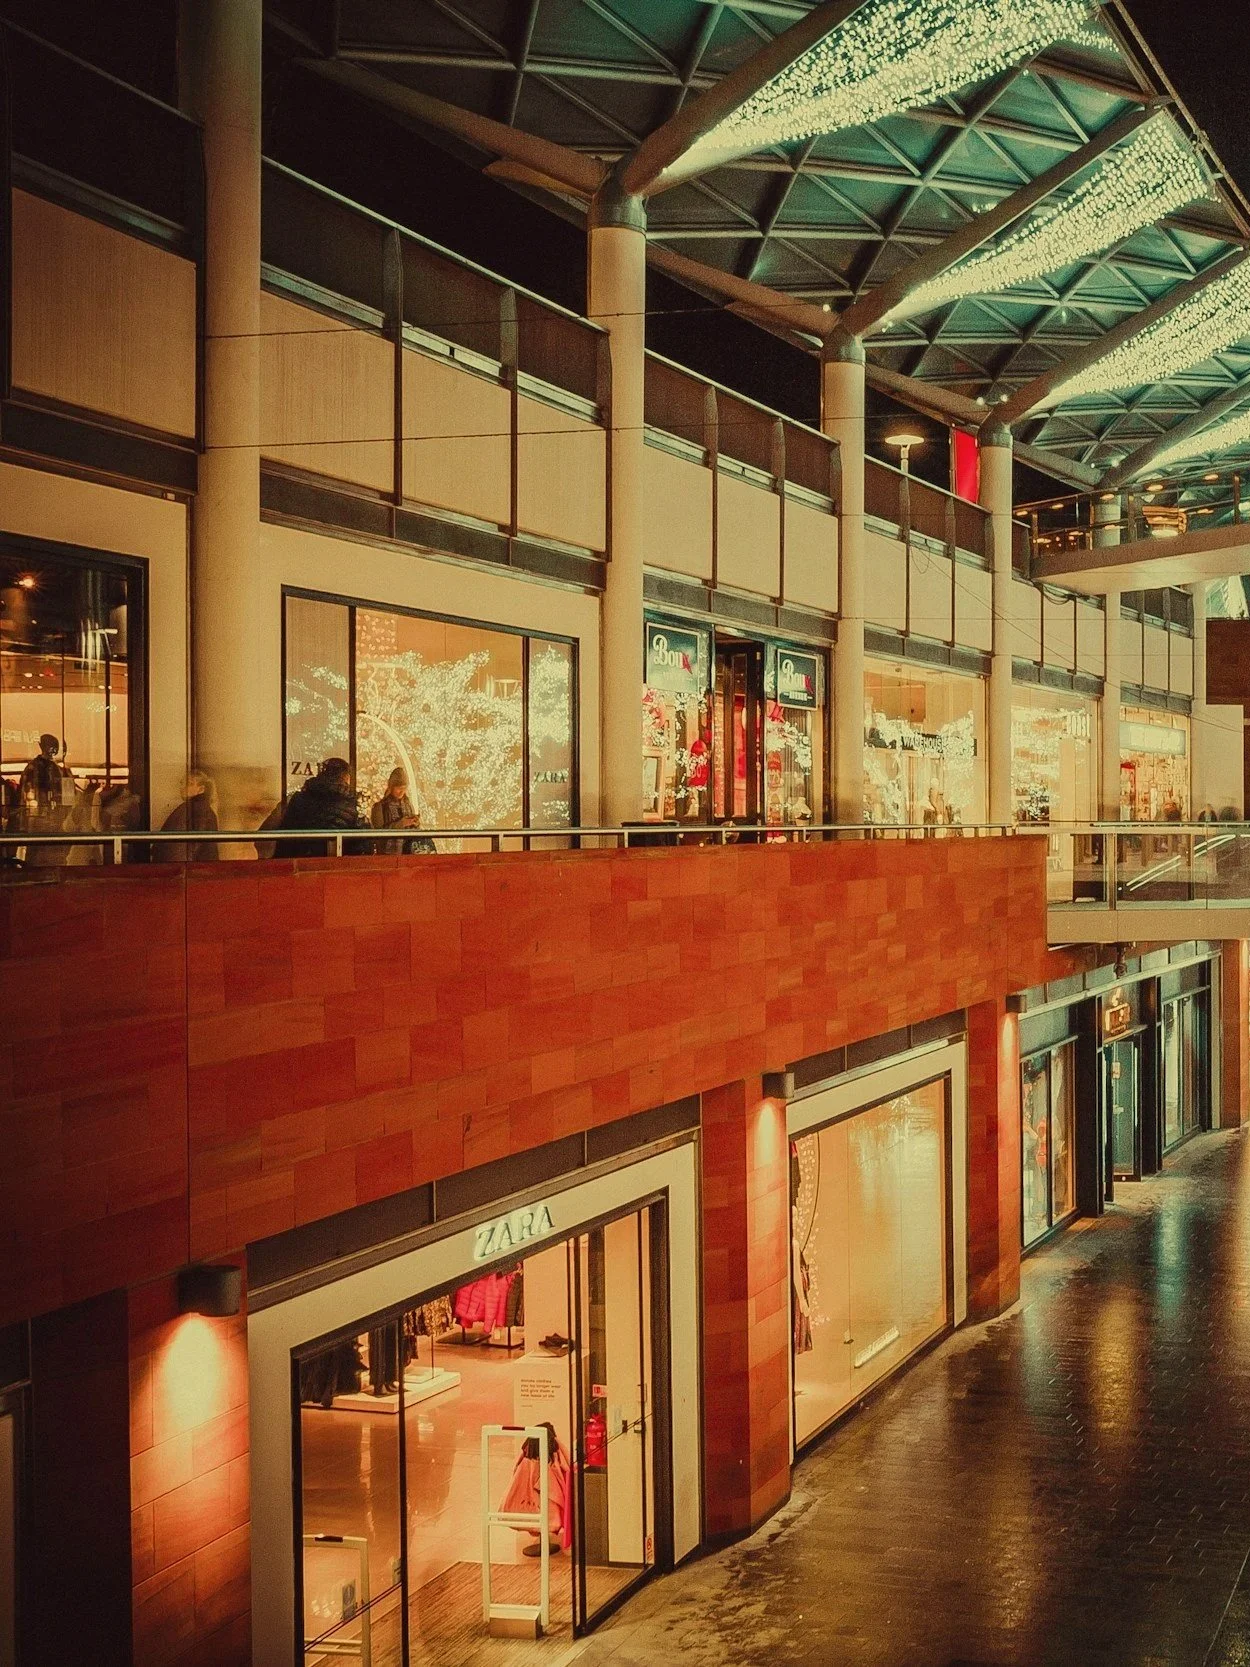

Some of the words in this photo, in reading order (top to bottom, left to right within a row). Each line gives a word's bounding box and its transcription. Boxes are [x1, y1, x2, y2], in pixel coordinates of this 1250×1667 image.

[901, 734, 946, 752] WAREHOUS
[534, 771, 567, 783] ZARA
[475, 1205, 555, 1260] ZARA
